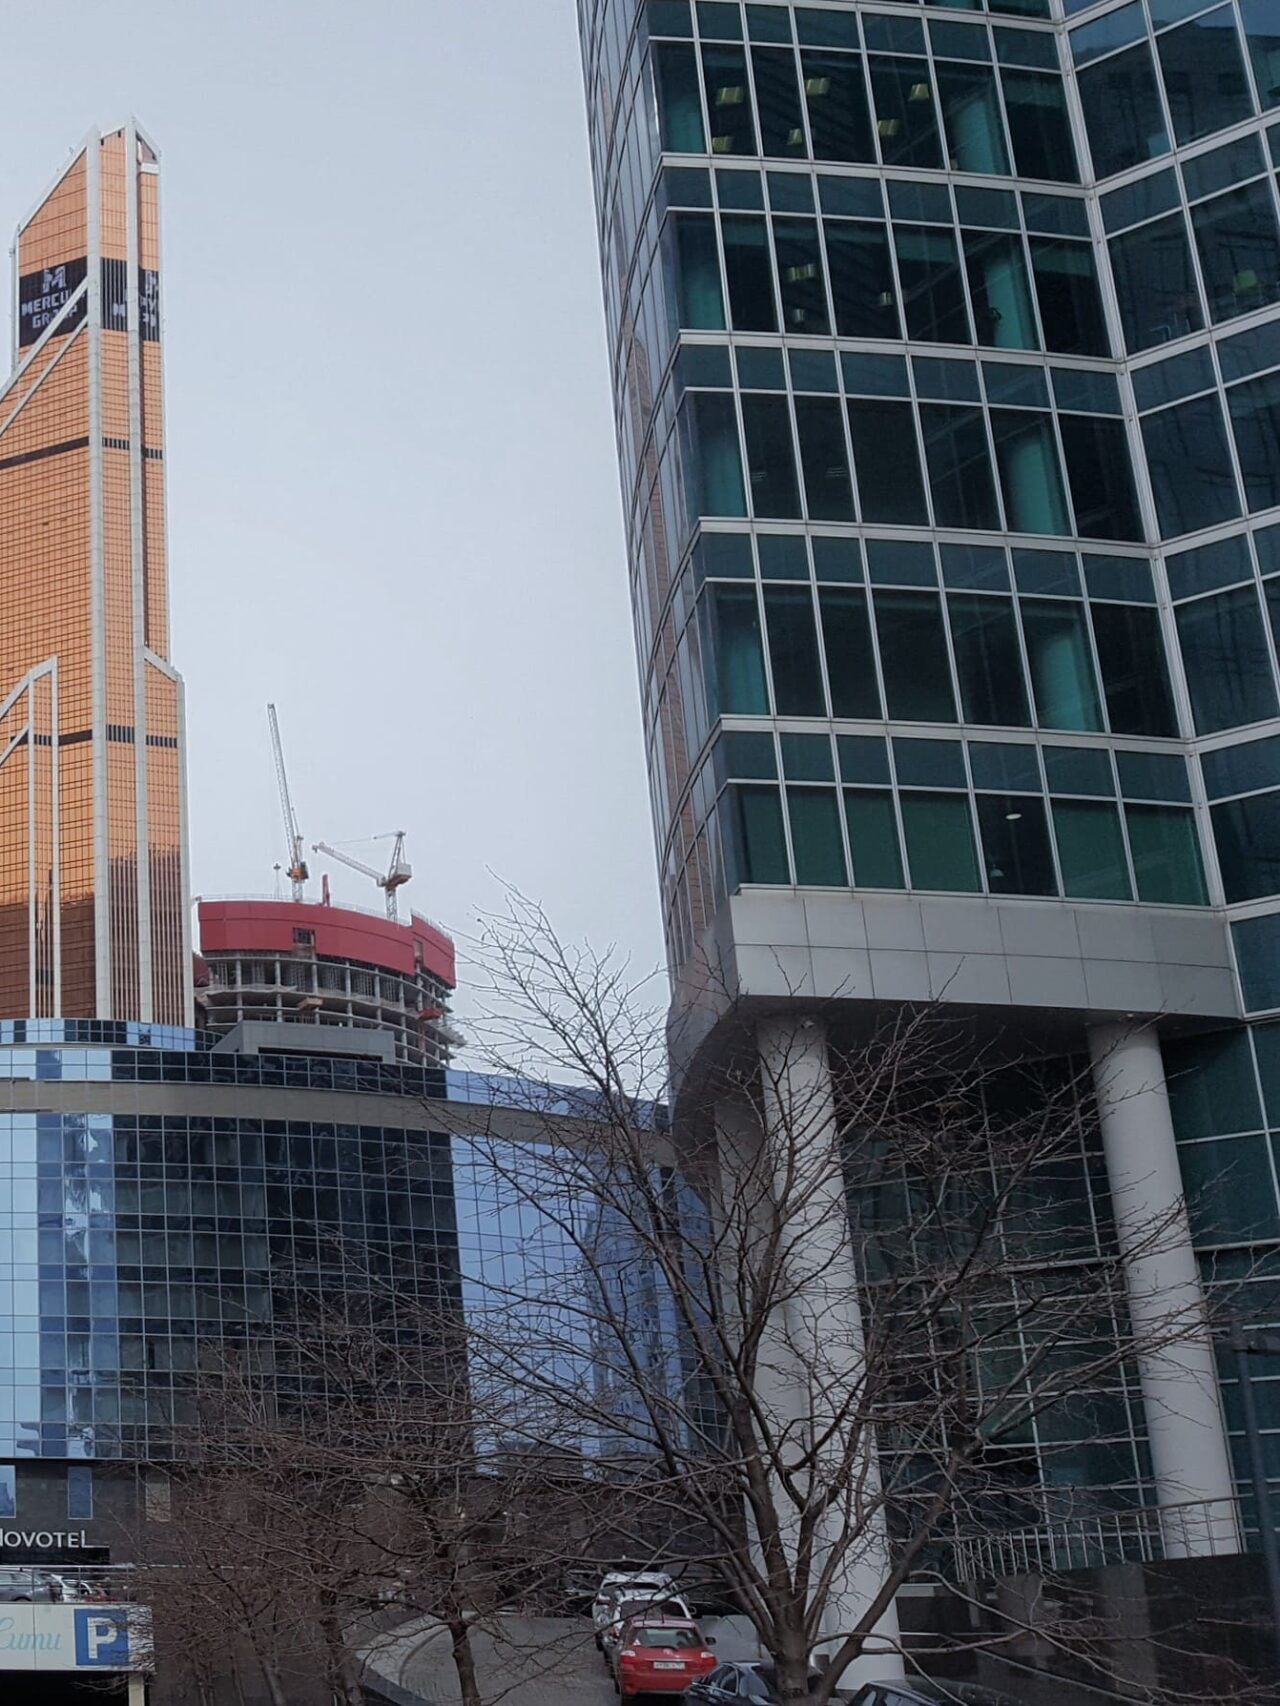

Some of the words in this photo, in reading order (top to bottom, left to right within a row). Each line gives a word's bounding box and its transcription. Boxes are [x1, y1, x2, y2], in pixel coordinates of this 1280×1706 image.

[21, 289, 85, 317] MERCU
[32, 304, 78, 328] GRP
[86, 1616, 118, 1659] P
